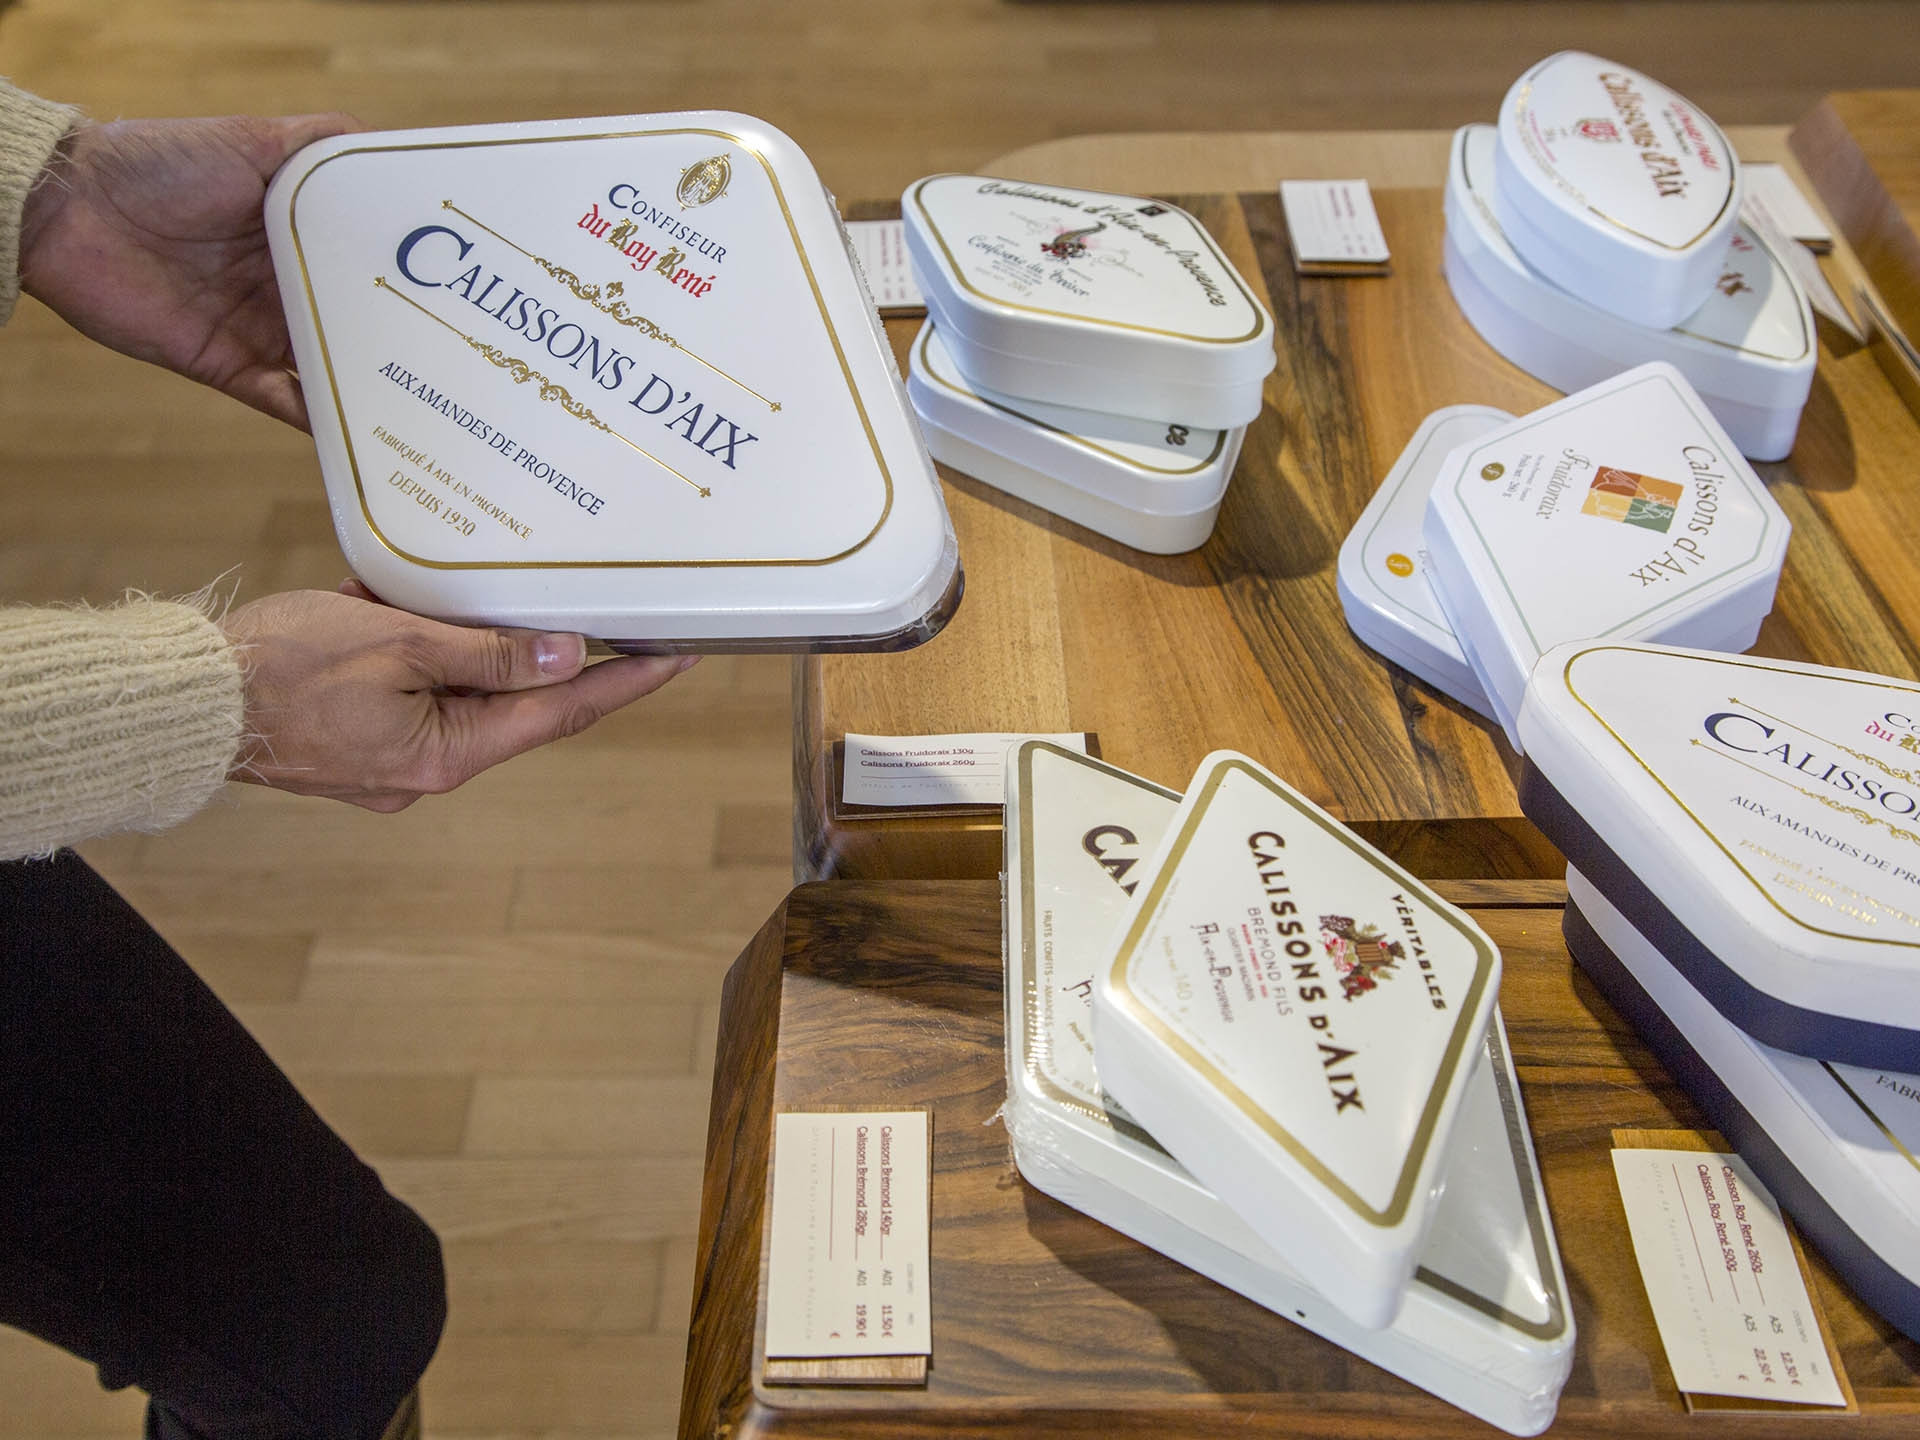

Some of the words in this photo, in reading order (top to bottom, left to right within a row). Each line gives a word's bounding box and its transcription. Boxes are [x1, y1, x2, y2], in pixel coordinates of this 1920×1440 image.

[608, 183, 727, 264] CONFISEUR
[577, 203, 612, 238] du
[605, 218, 658, 272] Roy
[654, 246, 717, 298] René
[395, 224, 637, 392] CALISSONS
[629, 373, 759, 470] D'AIX
[372, 425, 427, 467] FABRIQUÉ
[378, 361, 418, 391] AUX
[411, 383, 493, 440] AMANDES
[488, 431, 518, 457] DE
[512, 448, 606, 516] PROVENCE
[388, 470, 444, 514] DEPUIS
[440, 506, 477, 537] 1920
[1682, 445, 1725, 536] Calissons
[1629, 537, 1706, 587] d'Aix
[1864, 720, 1895, 743] du
[860, 748, 903, 757] Calissons
[860, 760, 903, 769] Calissons
[952, 759, 976, 767] 260g
[1730, 795, 1770, 816] AUX
[1770, 813, 1861, 858] AMANDES
[1863, 853, 1891, 871] DE
[1893, 866, 1920, 886] PR
[1391, 893, 1448, 1010] VÉRITABLES
[1247, 830, 1328, 1004] CALISSONS
[1308, 1014, 1366, 1115] D'AIX
[1272, 986, 1294, 1017] FILS
[856, 1126, 869, 1166] Calissons
[880, 1126, 893, 1166] Calissons
[856, 1167, 868, 1208] Brémond
[880, 1167, 893, 1208] Brémond
[1697, 1164, 1716, 1202] Calisson
[1721, 1165, 1740, 1202] Calisson
[855, 1208, 868, 1237] 280gr
[879, 1210, 893, 1237] 140gr
[1710, 1202, 1723, 1222] Roy
[1734, 1202, 1747, 1223] Roy
[1715, 1222, 1730, 1248] René
[1740, 1224, 1756, 1249] René
[1722, 1248, 1738, 1273] 500g
[1748, 1249, 1763, 1274] 260g
